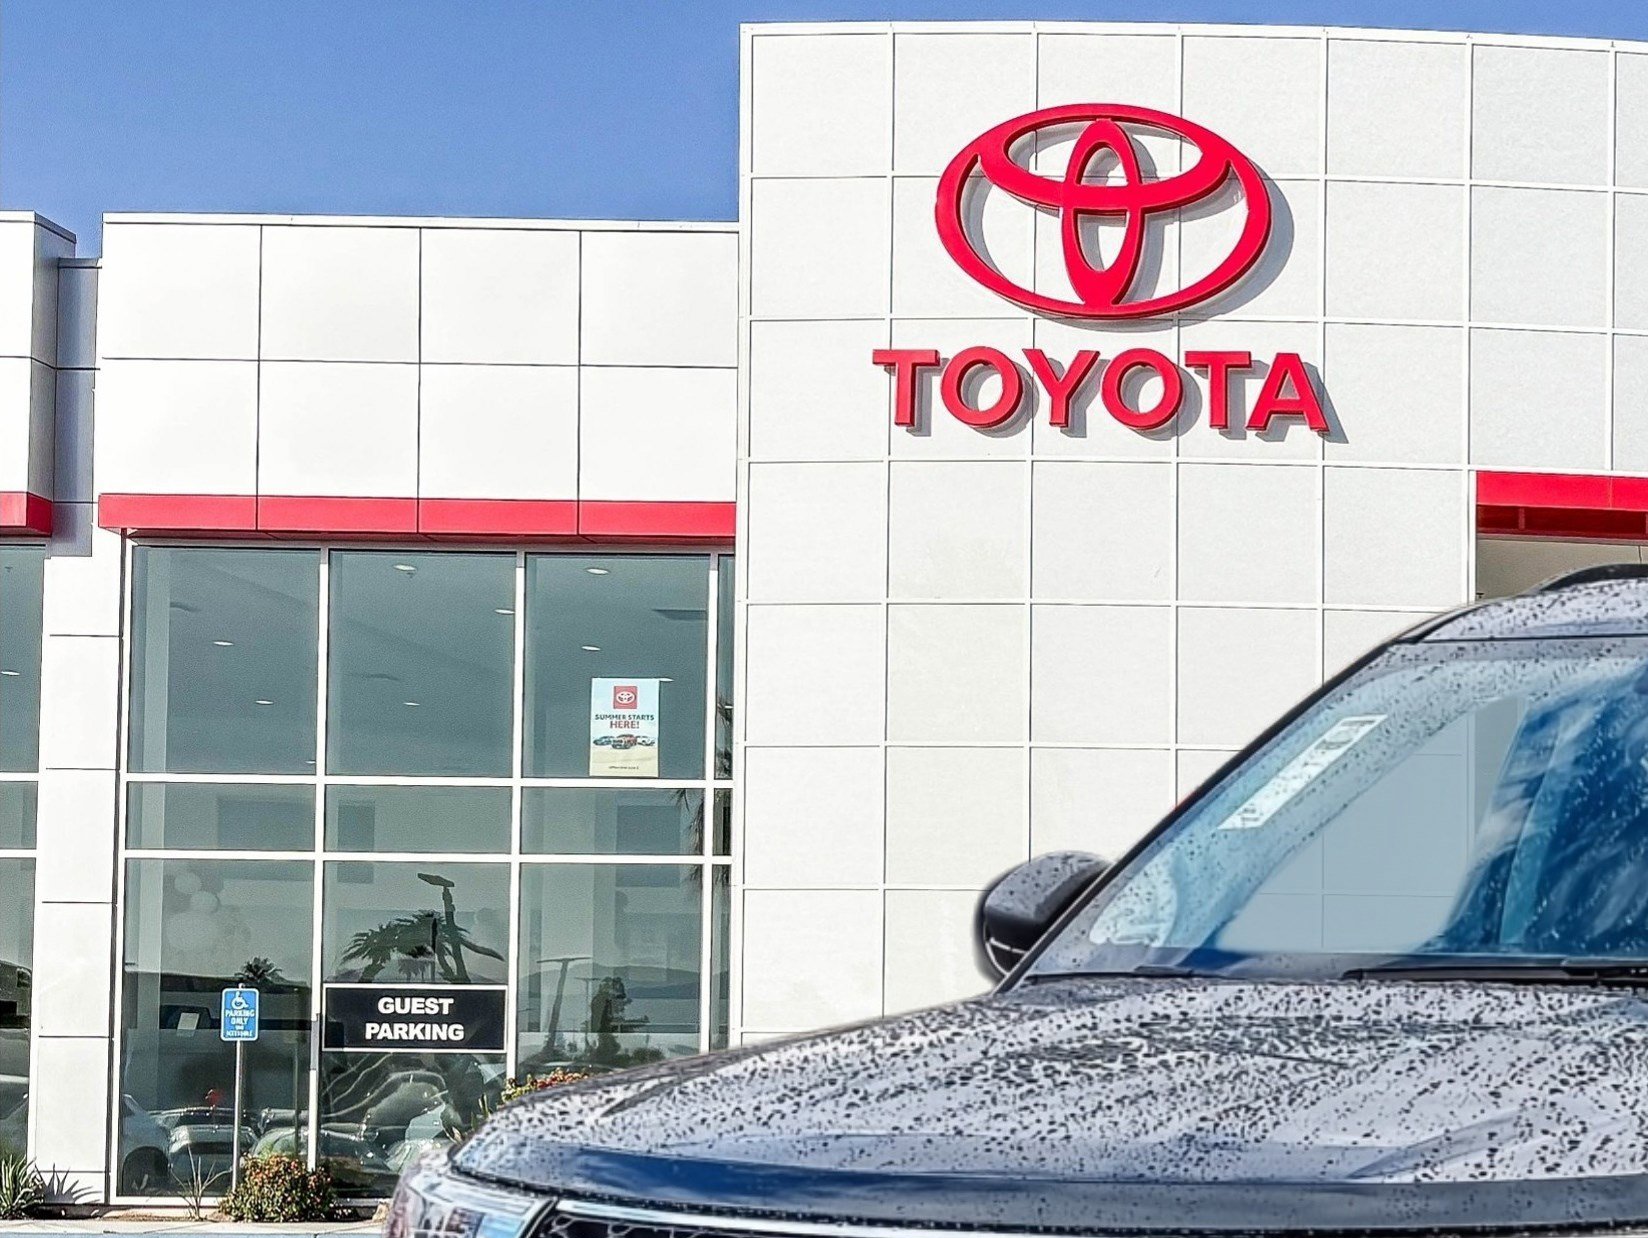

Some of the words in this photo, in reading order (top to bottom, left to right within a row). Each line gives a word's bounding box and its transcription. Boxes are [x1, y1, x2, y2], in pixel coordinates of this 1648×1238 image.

[873, 346, 1329, 434] TOYOTA
[610, 720, 640, 729] HERE!
[377, 996, 454, 1015] GUEST
[225, 1009, 256, 1018] PARKING
[230, 1017, 249, 1025] ONLY
[365, 1022, 464, 1041] PARKING
